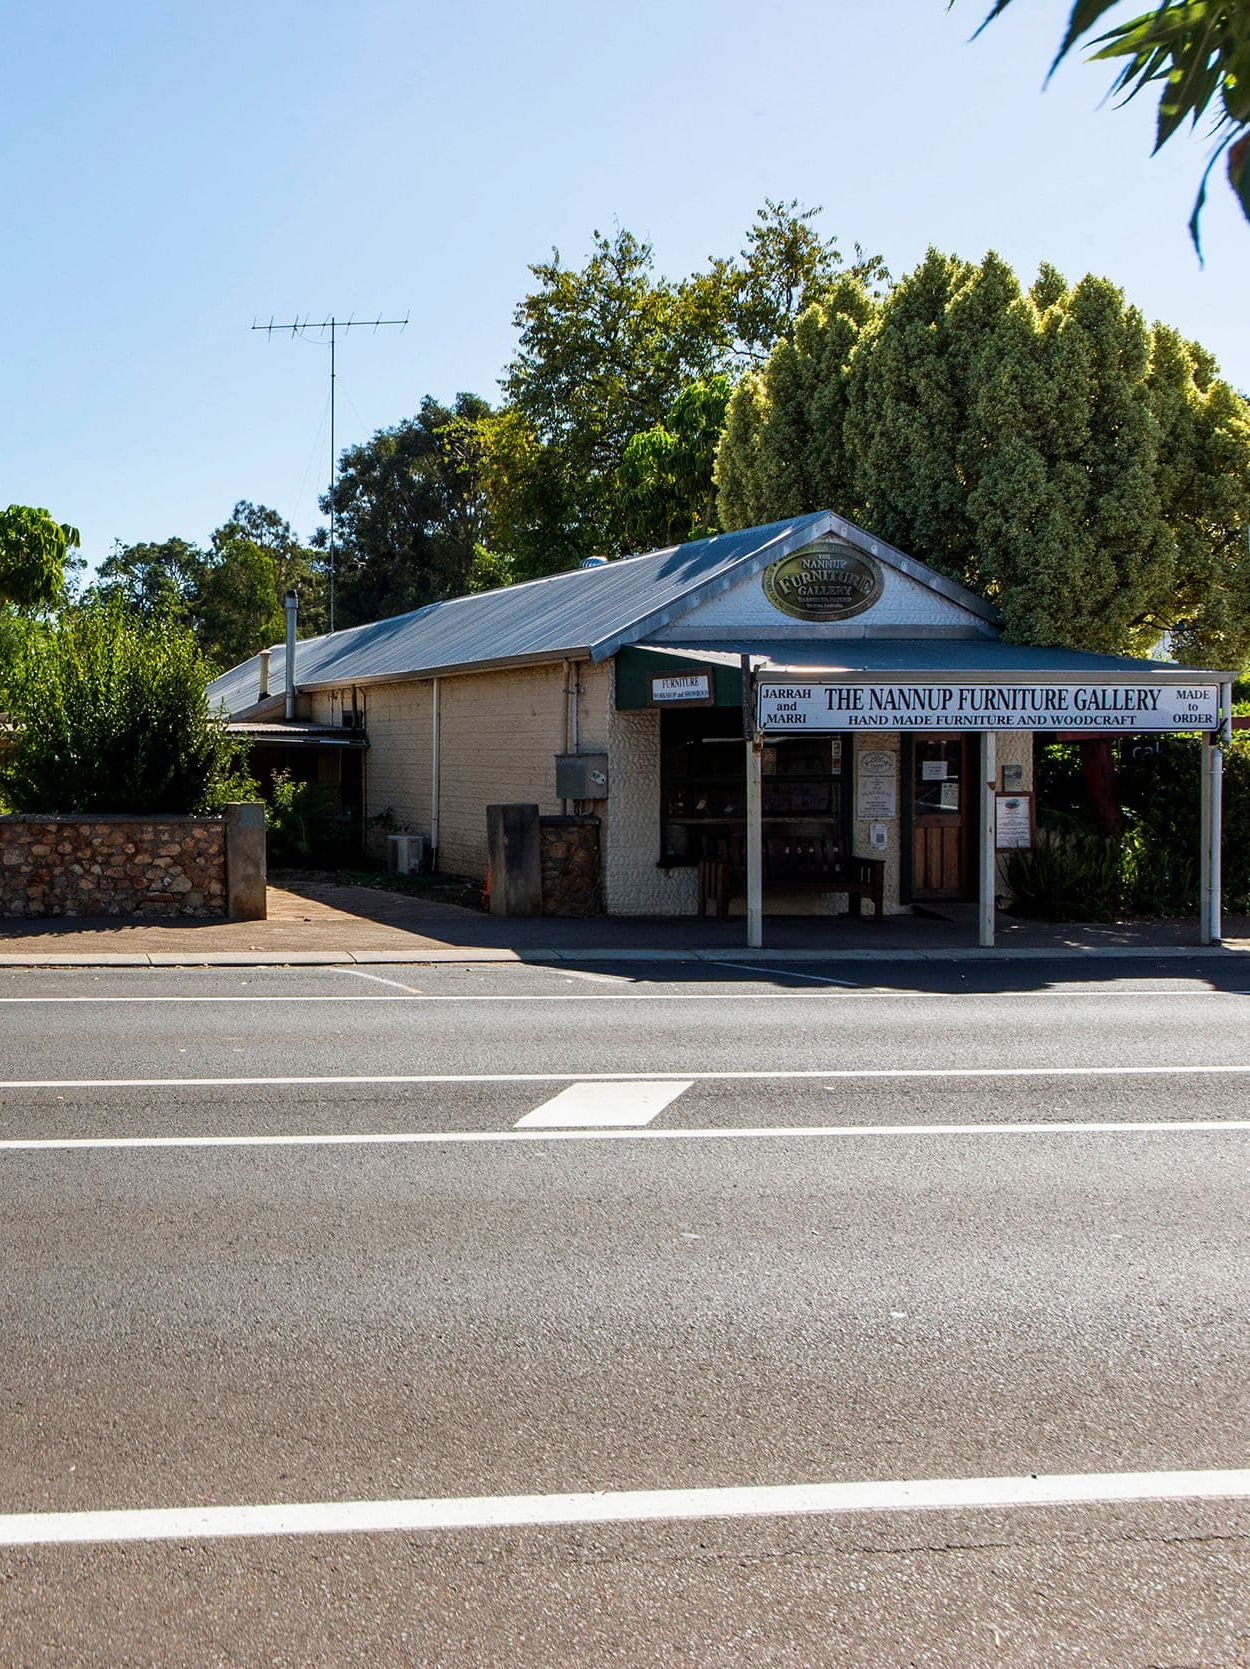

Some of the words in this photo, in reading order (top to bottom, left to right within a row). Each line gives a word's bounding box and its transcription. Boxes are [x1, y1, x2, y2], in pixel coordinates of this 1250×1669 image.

[802, 559, 847, 569] NANNUP
[779, 569, 874, 595] FURNITURE
[797, 585, 852, 596] GALLERY
[662, 677, 700, 688] FURNITURE
[763, 689, 811, 699] JARRAH
[1176, 690, 1210, 700] MADE
[824, 688, 864, 711] THE
[869, 688, 953, 711] NANNUP
[958, 688, 1069, 711] FURNITURE
[1074, 688, 1162, 711] GALLERY
[776, 702, 797, 711] and
[1188, 703, 1198, 711] to
[766, 714, 806, 724] MARRI
[849, 715, 888, 725] HAND
[892, 715, 933, 725] MADE
[936, 715, 1014, 725] FURNITURE
[1017, 715, 1047, 725] AND
[1051, 715, 1137, 725] WOODCRAFT
[1172, 713, 1213, 723] ORDER
